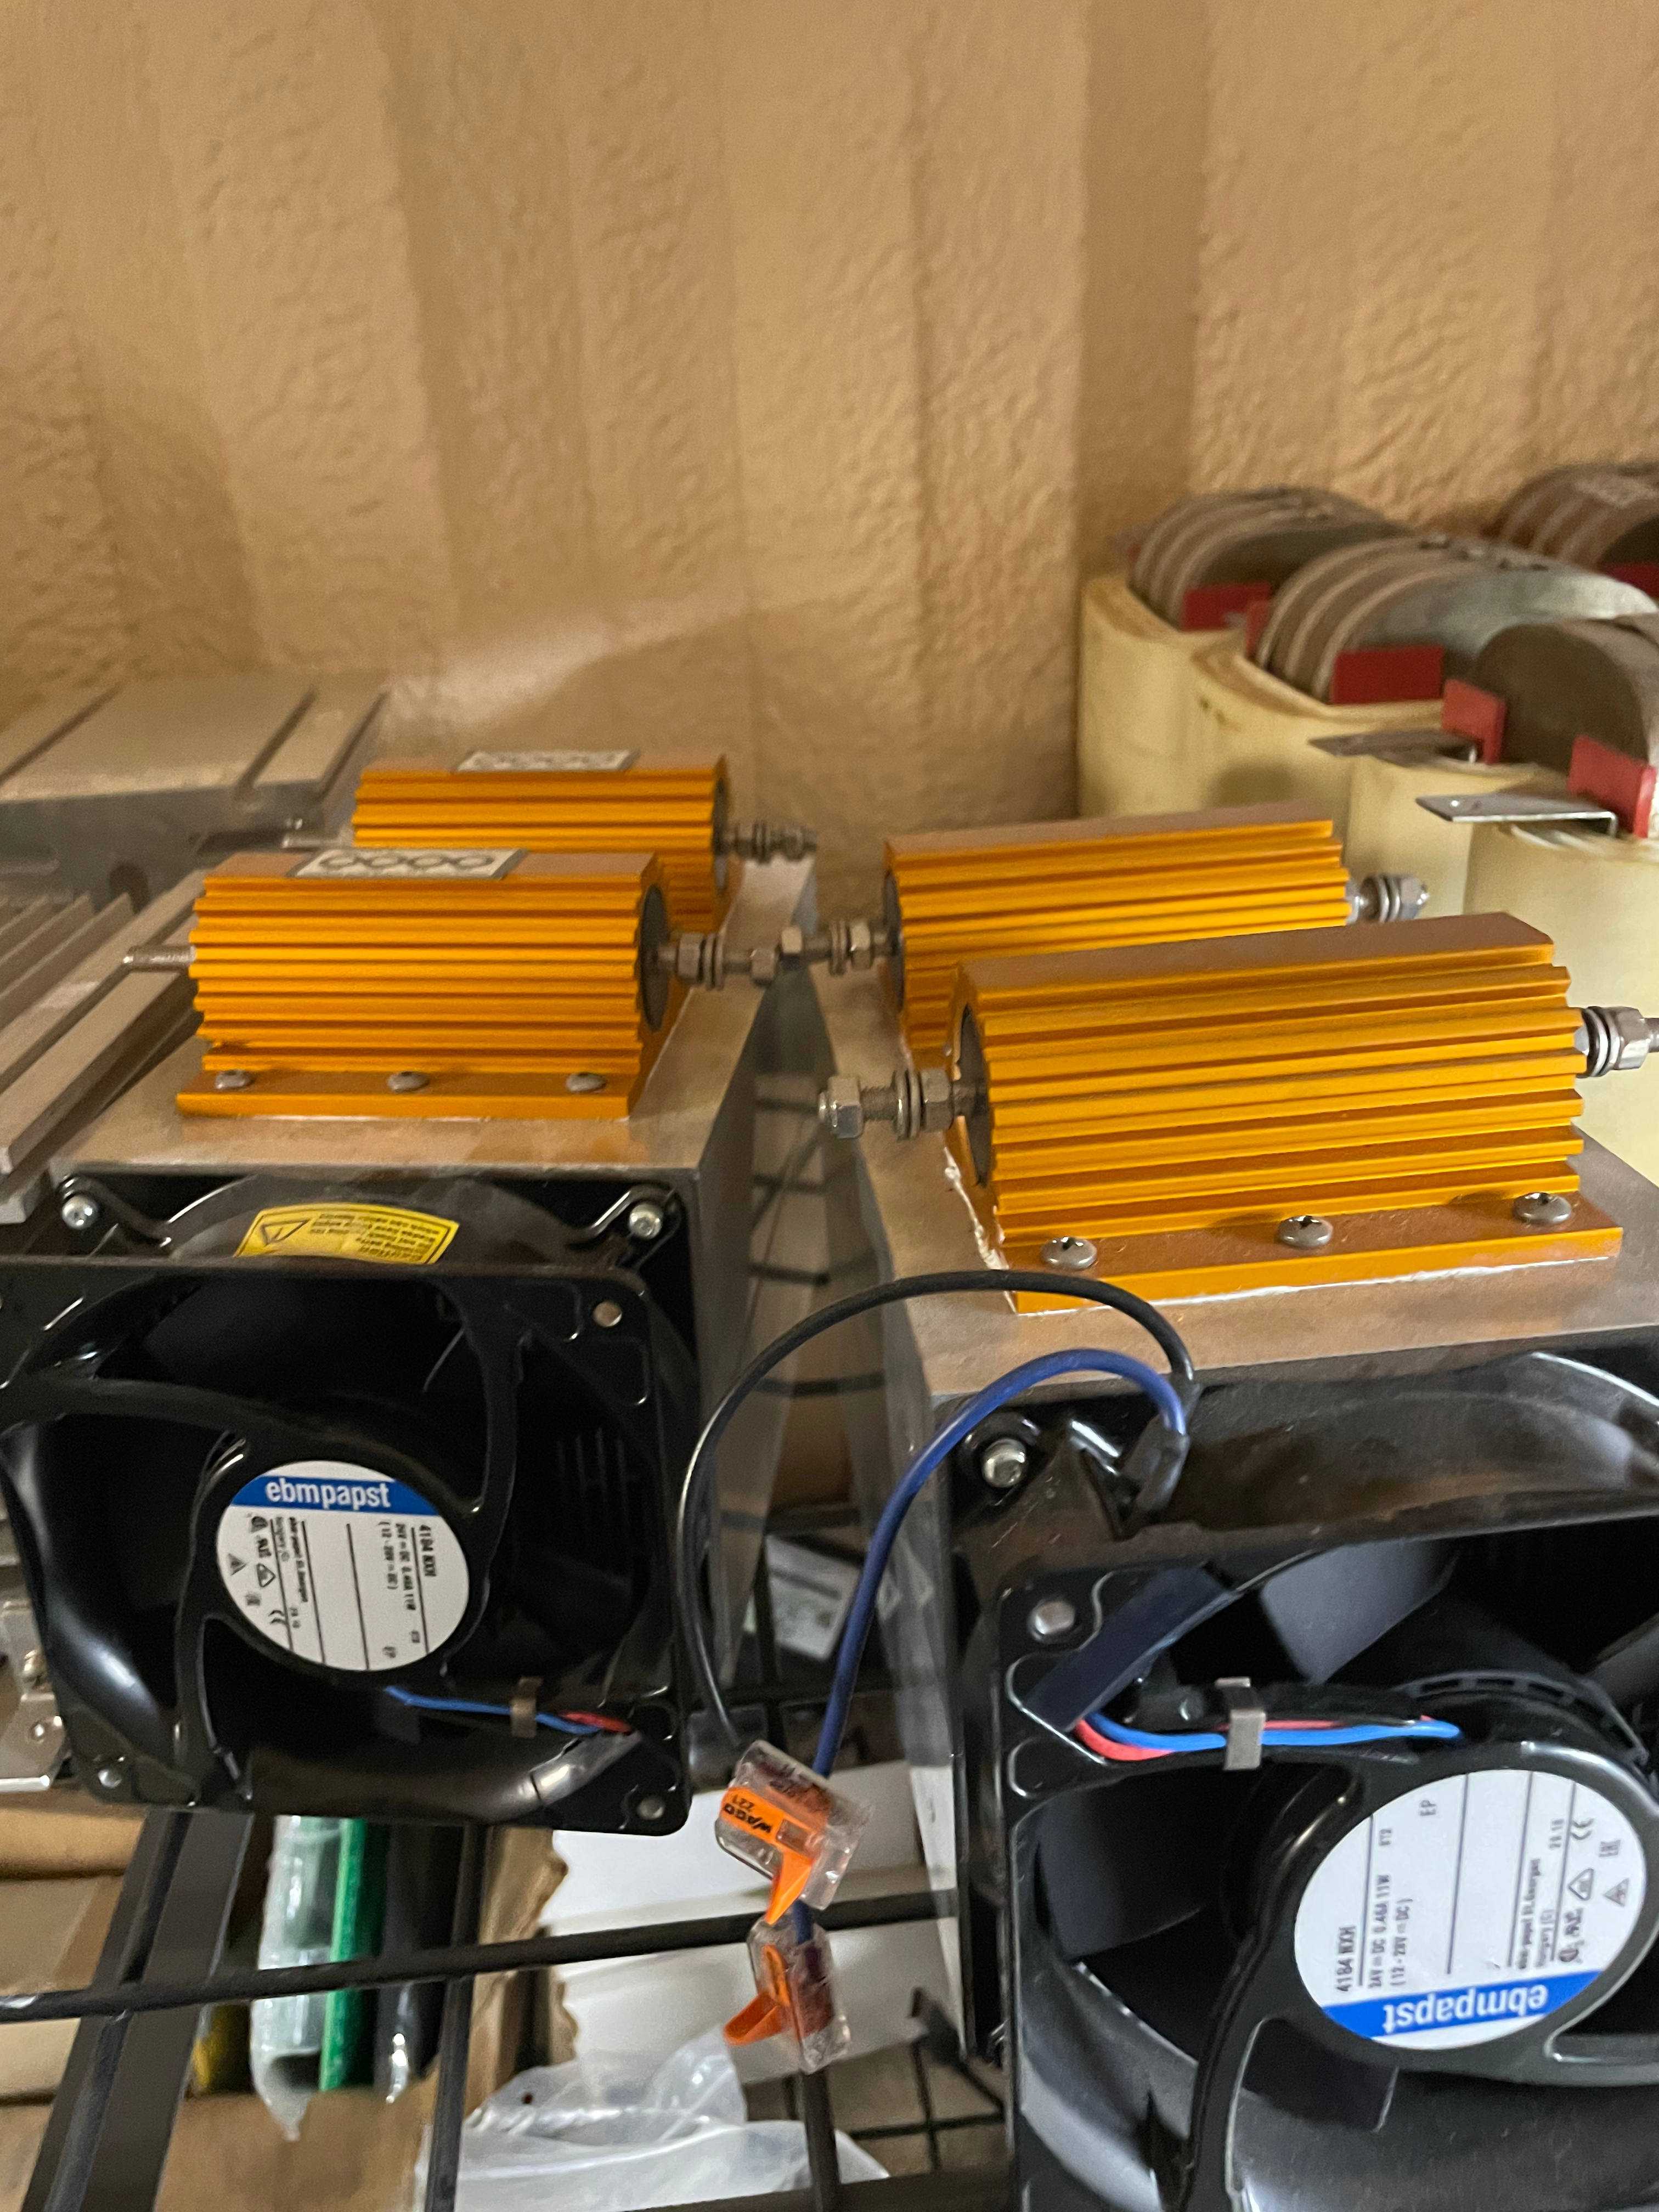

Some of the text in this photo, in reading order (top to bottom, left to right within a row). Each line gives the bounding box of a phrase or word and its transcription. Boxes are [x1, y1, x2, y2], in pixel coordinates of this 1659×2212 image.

[265, 1477, 391, 1511] ebmpapst
[1419, 1800, 1437, 1816] EP
[1382, 1984, 1548, 2034] ebmpapst
